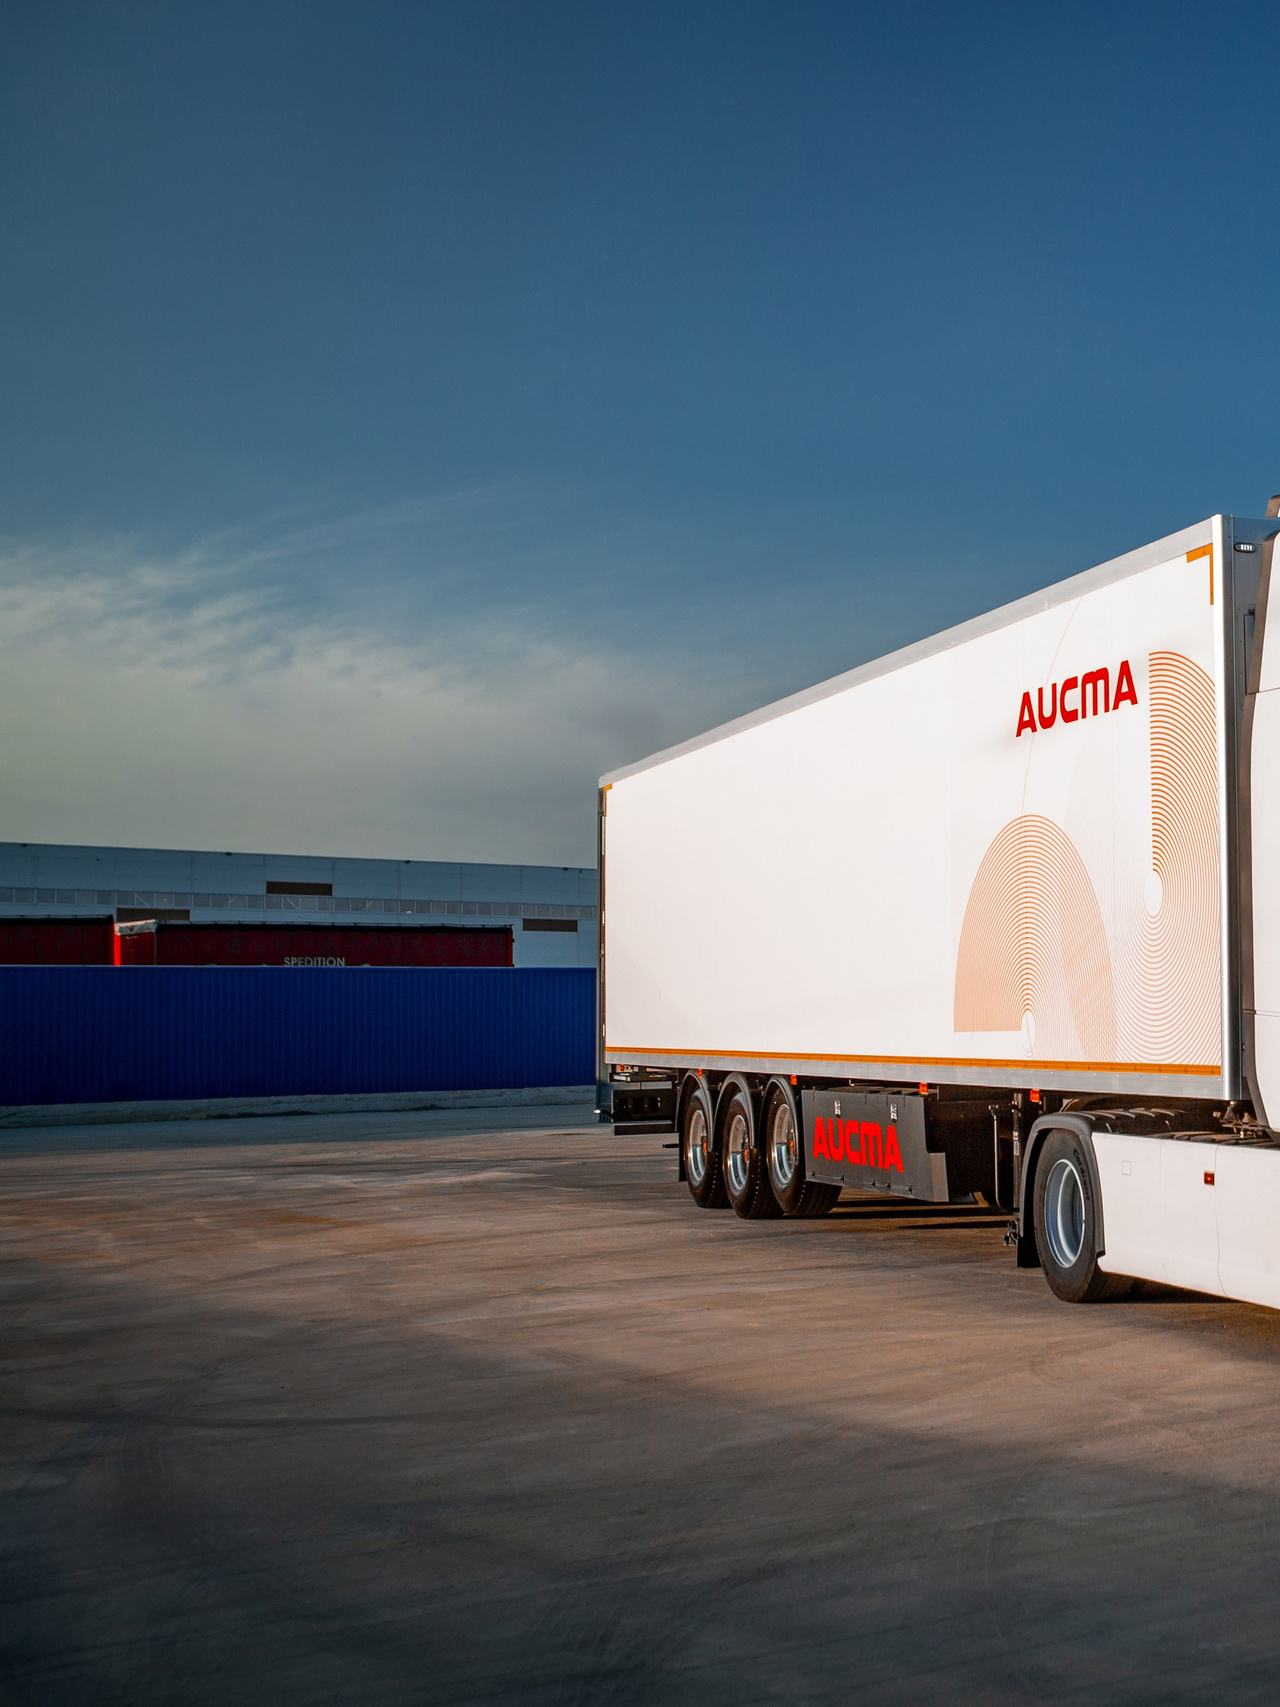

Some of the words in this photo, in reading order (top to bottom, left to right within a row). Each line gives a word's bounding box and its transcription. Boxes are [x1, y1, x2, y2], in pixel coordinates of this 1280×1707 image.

[1016, 660, 1138, 738] AUCMA
[284, 957, 346, 967] SPEDITION
[813, 1116, 904, 1173] AUCMA
